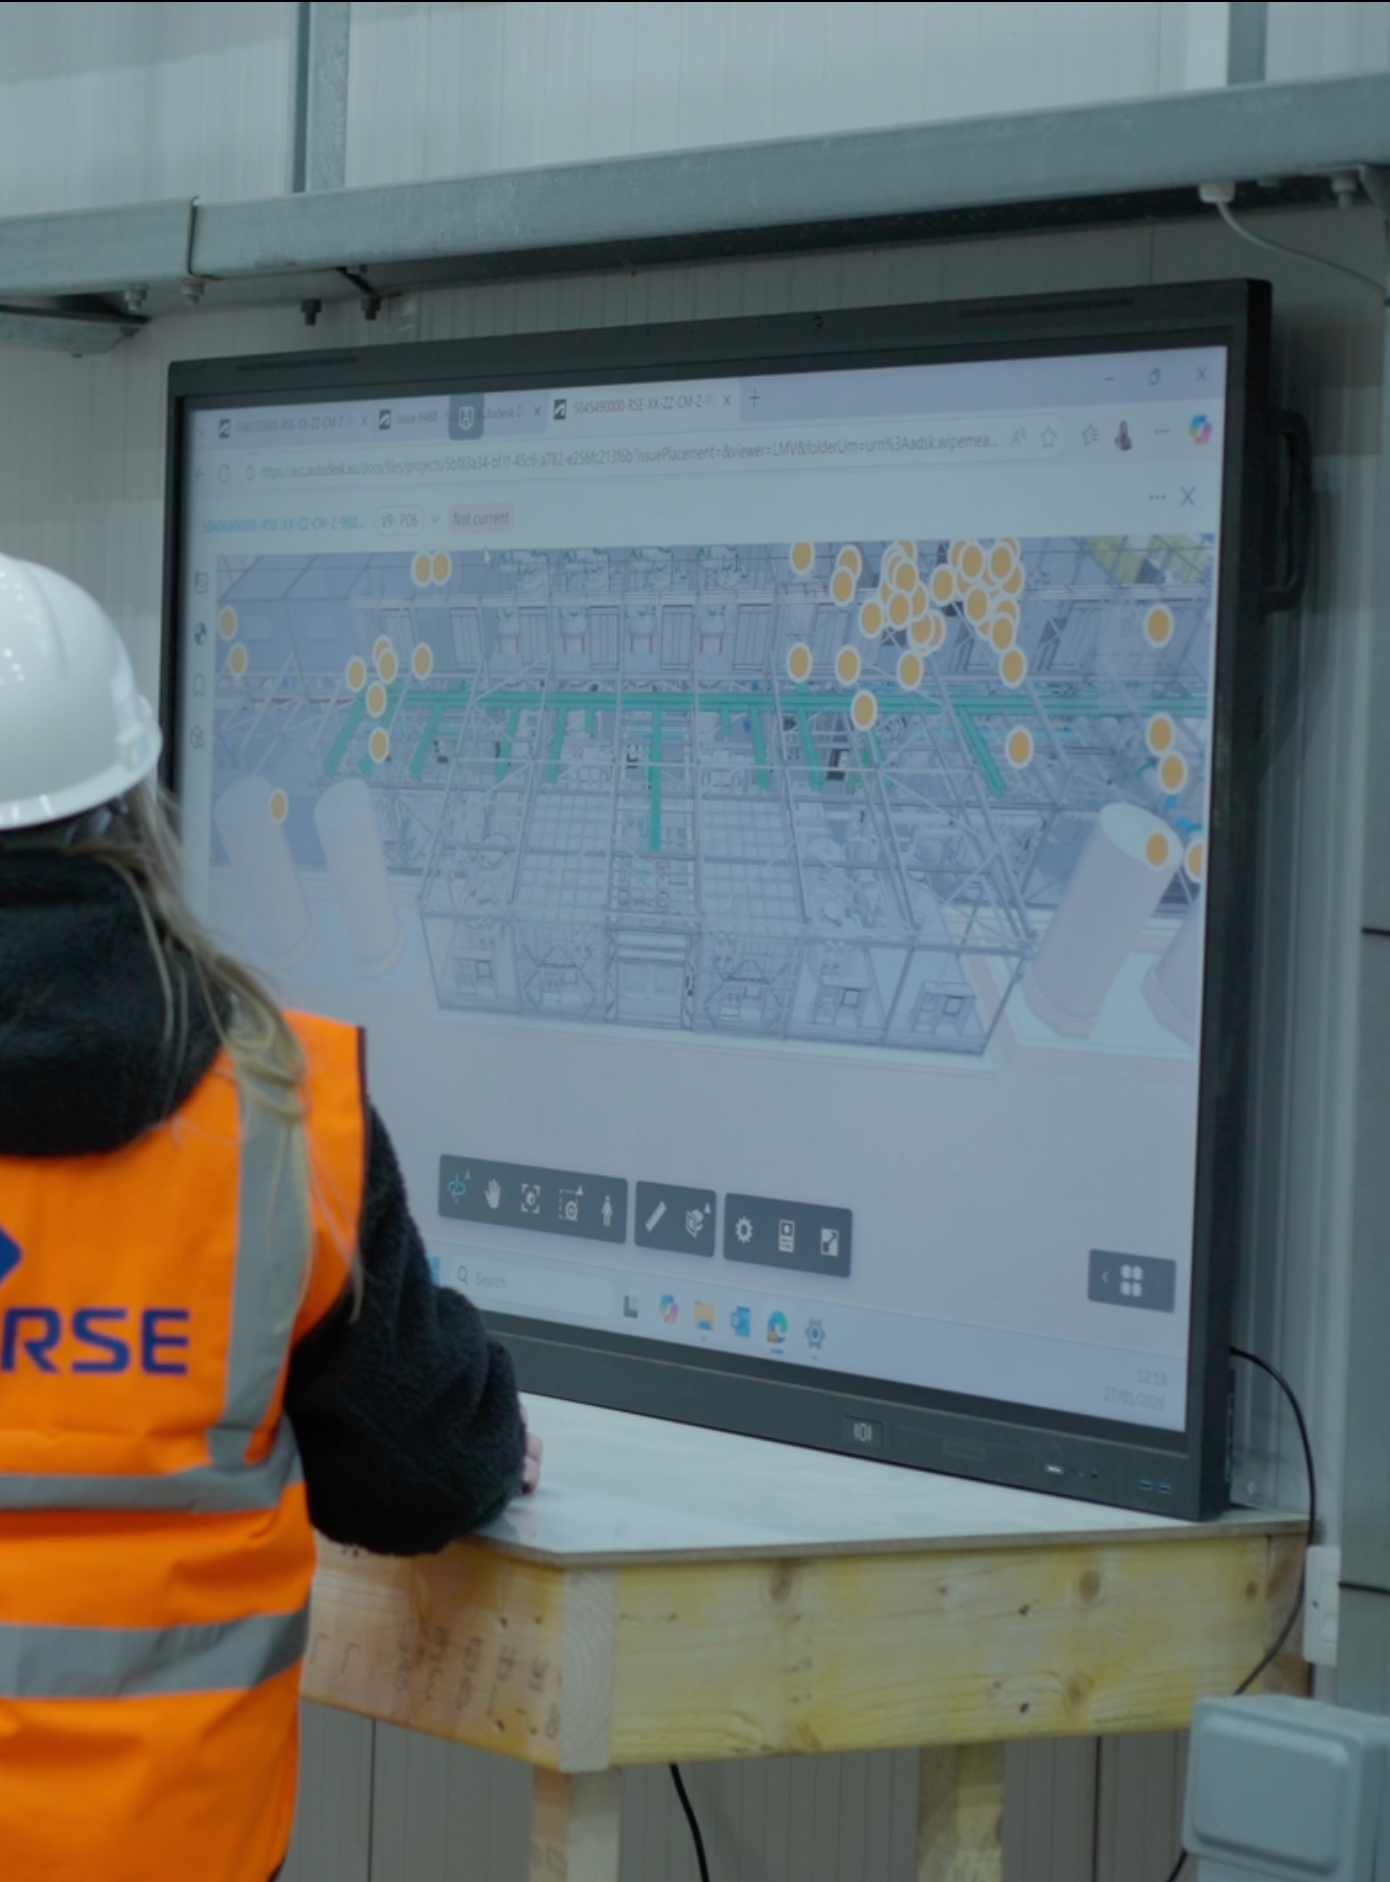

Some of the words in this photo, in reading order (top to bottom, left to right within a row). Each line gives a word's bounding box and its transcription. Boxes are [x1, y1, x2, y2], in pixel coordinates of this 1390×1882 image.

[453, 511, 470, 525] Not
[473, 511, 509, 525] current
[476, 1271, 507, 1289] Search
[0, 1306, 190, 1375] RSE
